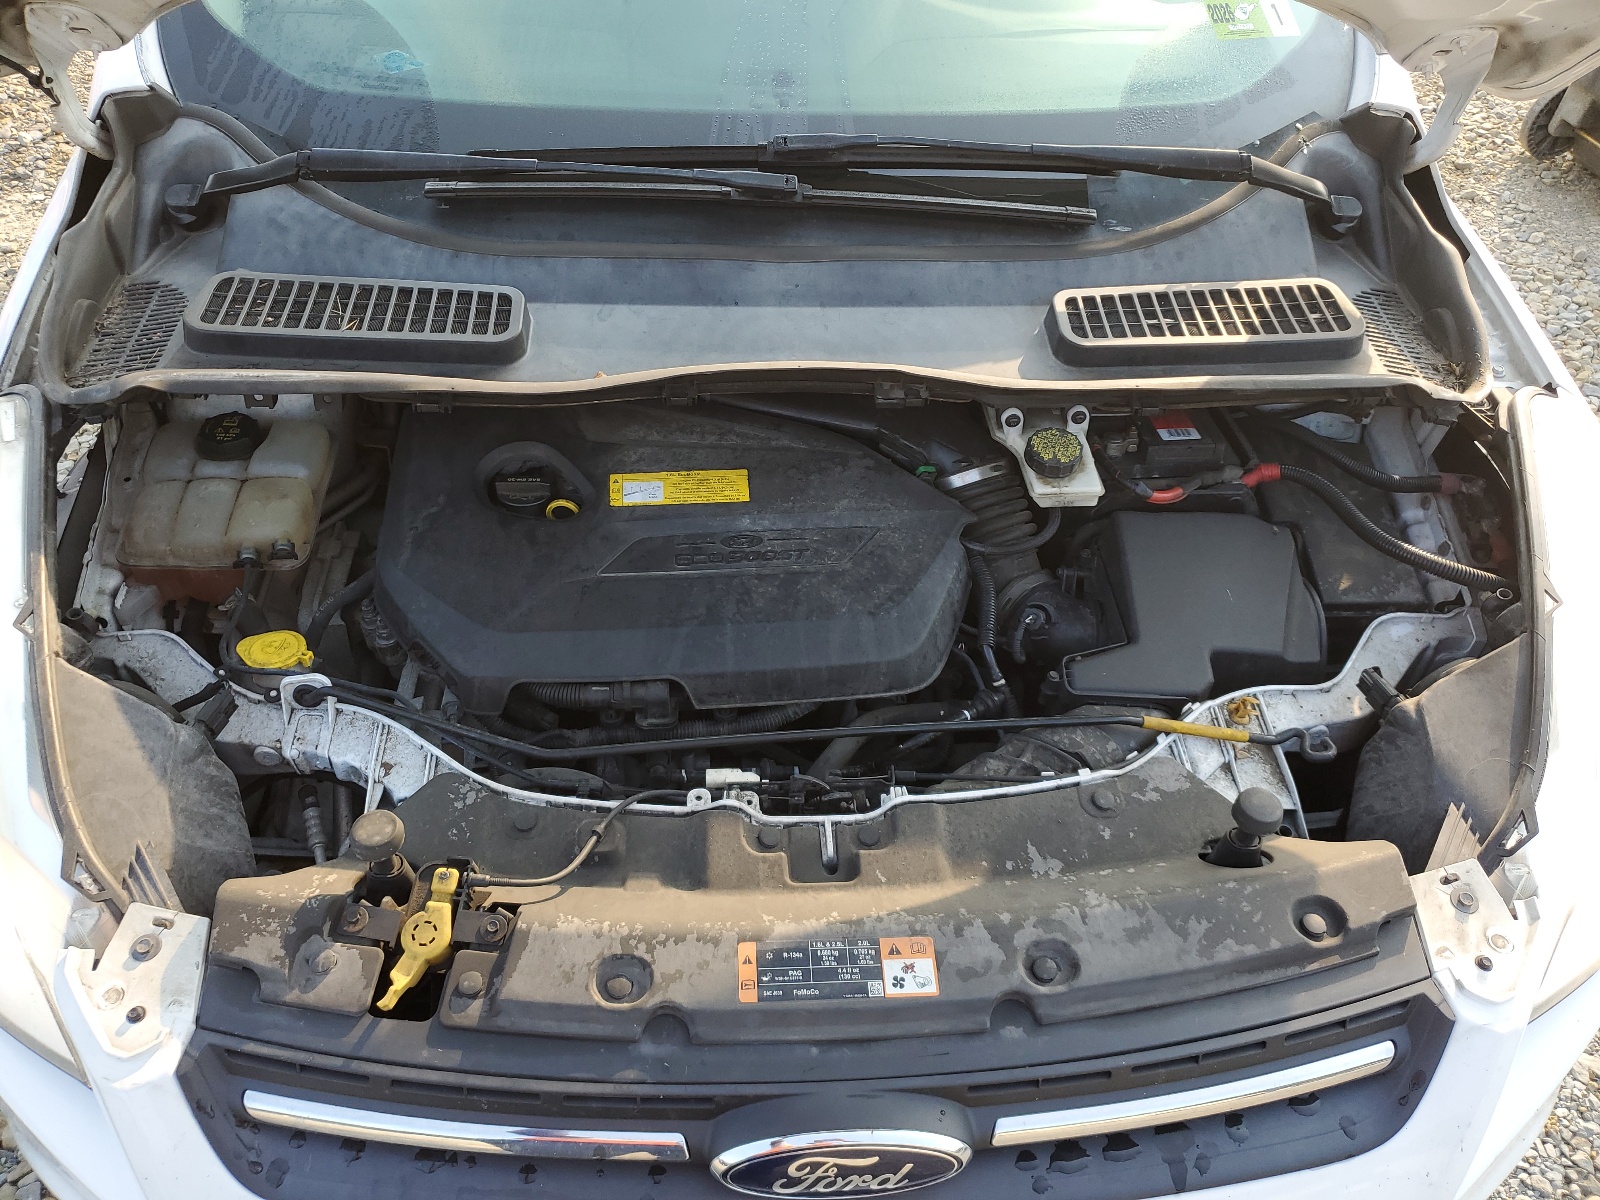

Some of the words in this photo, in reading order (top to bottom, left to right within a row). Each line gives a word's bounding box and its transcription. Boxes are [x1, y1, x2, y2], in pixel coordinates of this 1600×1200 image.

[1207, 3, 1236, 23] 2026
[793, 988, 820, 996] FoMoCo
[772, 1156, 914, 1194] Ford
